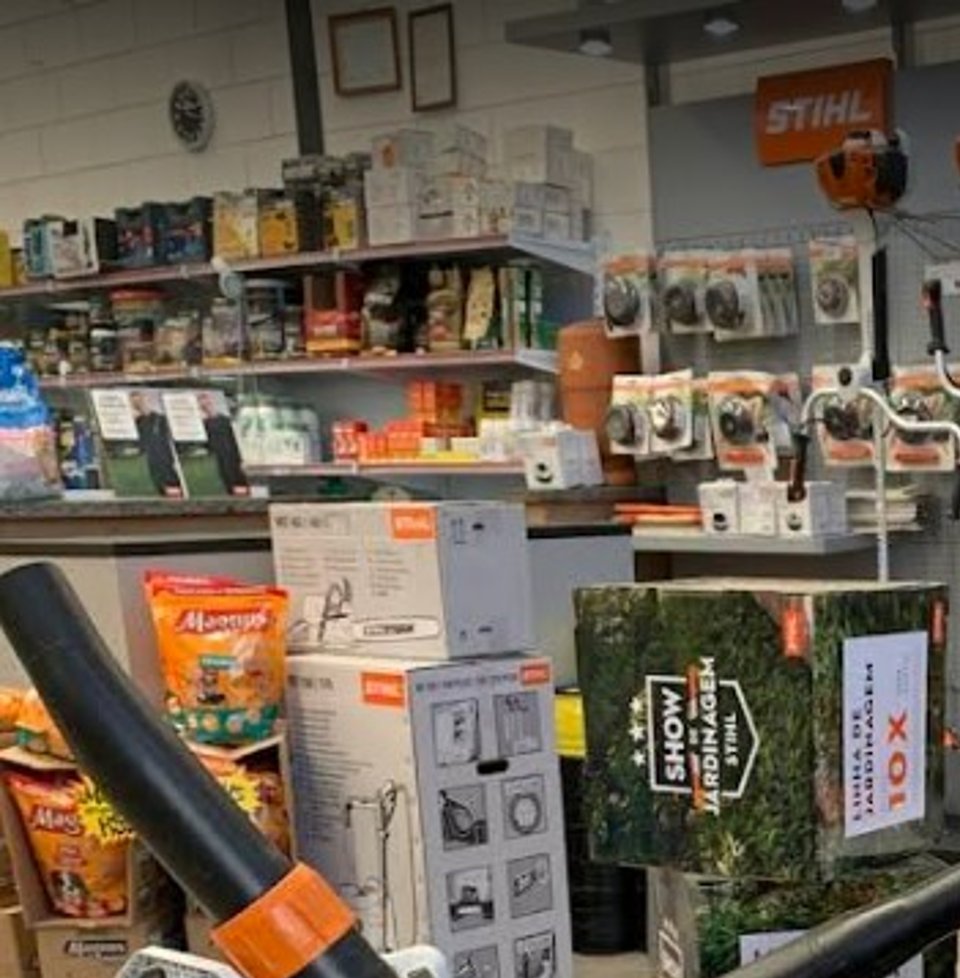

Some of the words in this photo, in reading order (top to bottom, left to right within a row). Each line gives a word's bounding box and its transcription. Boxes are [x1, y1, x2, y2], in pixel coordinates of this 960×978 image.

[765, 89, 872, 135] STIHL
[661, 686, 686, 781] SHOW
[699, 656, 720, 816] JARDINAGEM
[723, 711, 739, 766] STIHL
[852, 709, 862, 739] DE
[864, 662, 875, 816] JARDINAGEM
